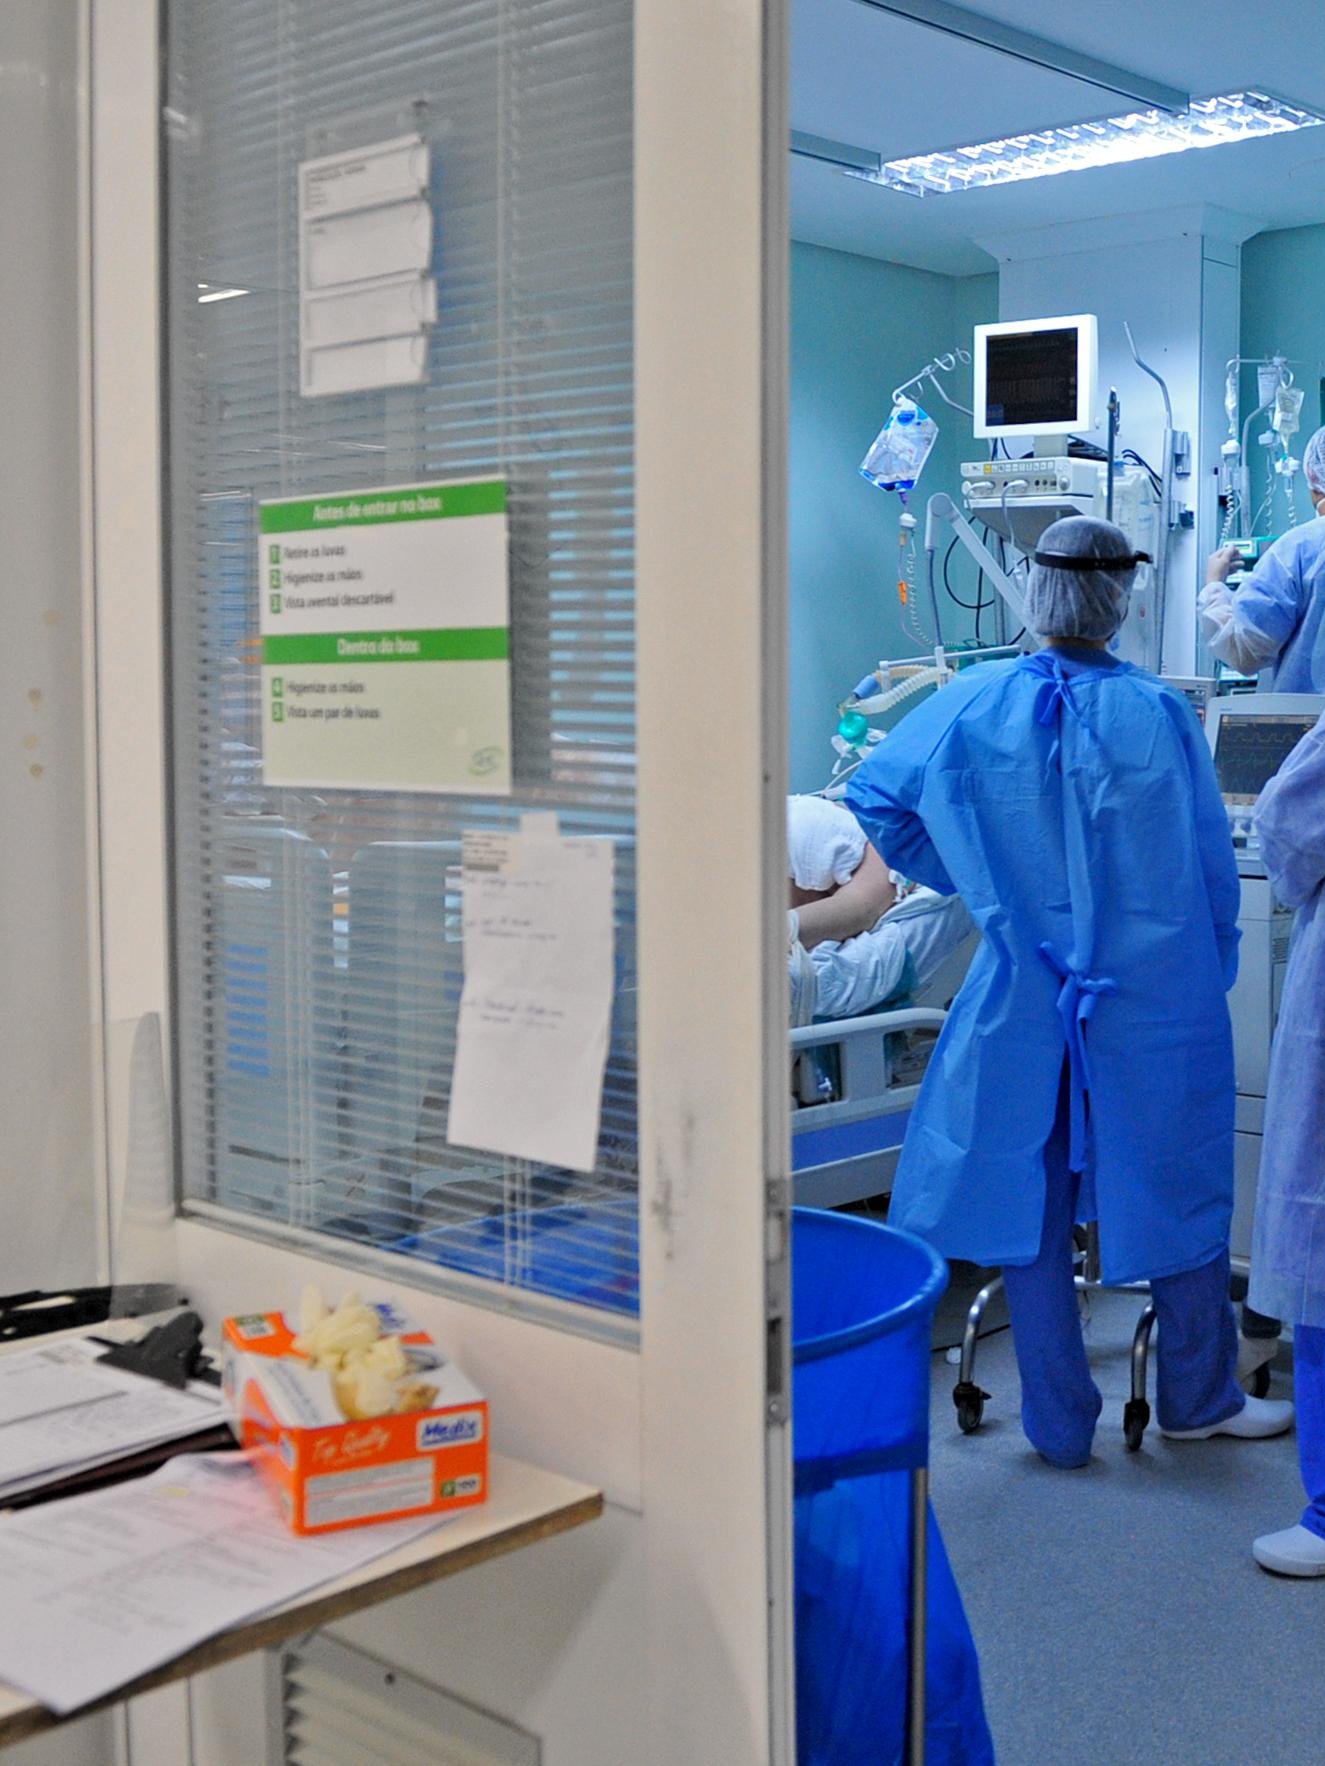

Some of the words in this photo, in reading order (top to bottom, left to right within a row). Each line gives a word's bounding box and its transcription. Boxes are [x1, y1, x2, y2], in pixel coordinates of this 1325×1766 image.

[313, 504, 344, 521] Antes
[346, 501, 361, 518] de
[363, 500, 397, 516] entrar
[400, 500, 416, 514] no
[417, 494, 442, 511] box
[285, 570, 324, 588] Higienize
[337, 639, 376, 655] Dentro
[394, 637, 419, 654] box
[287, 680, 326, 697] Higienize
[325, 708, 339, 721] par
[341, 705, 353, 718] de
[424, 1418, 477, 1441] Medix
